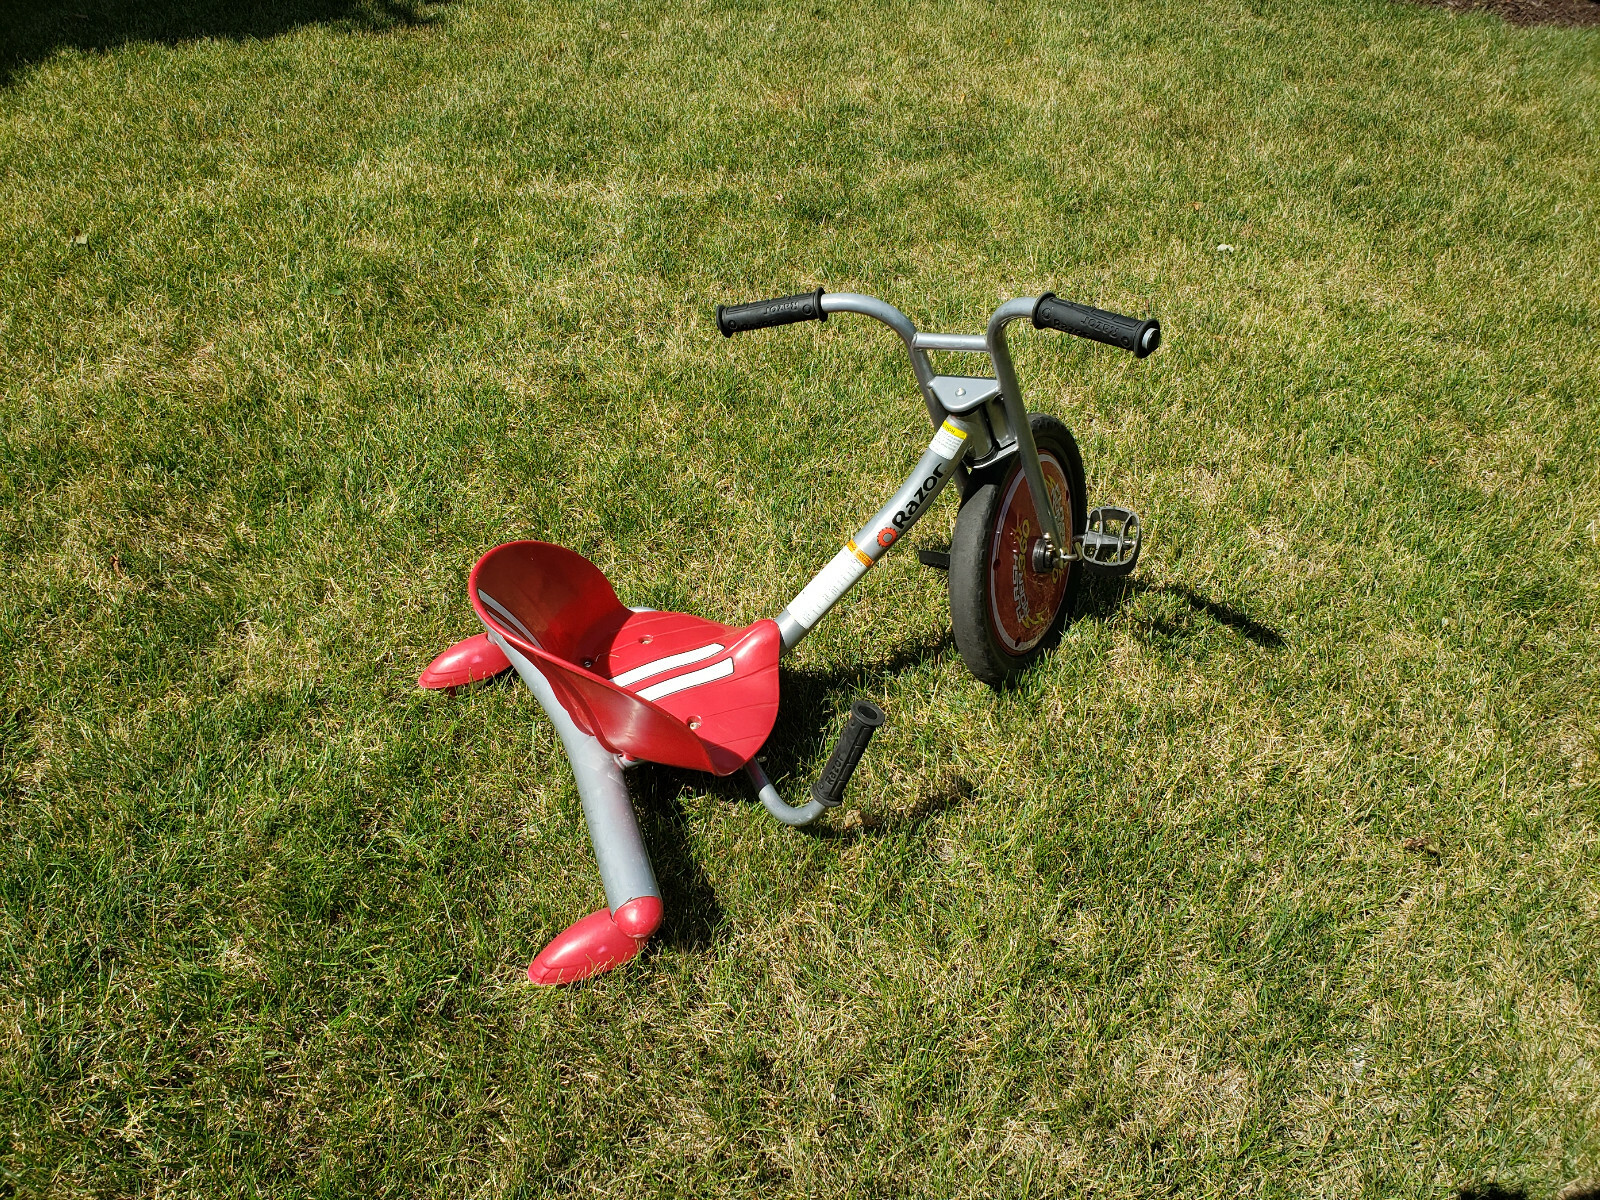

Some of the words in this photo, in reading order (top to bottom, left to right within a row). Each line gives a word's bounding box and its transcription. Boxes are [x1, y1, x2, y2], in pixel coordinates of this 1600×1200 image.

[763, 301, 799, 315] Razor
[1081, 316, 1119, 339] Razor
[891, 463, 943, 529] Razor
[1018, 519, 1030, 571] 360
[825, 754, 844, 785] Razor
